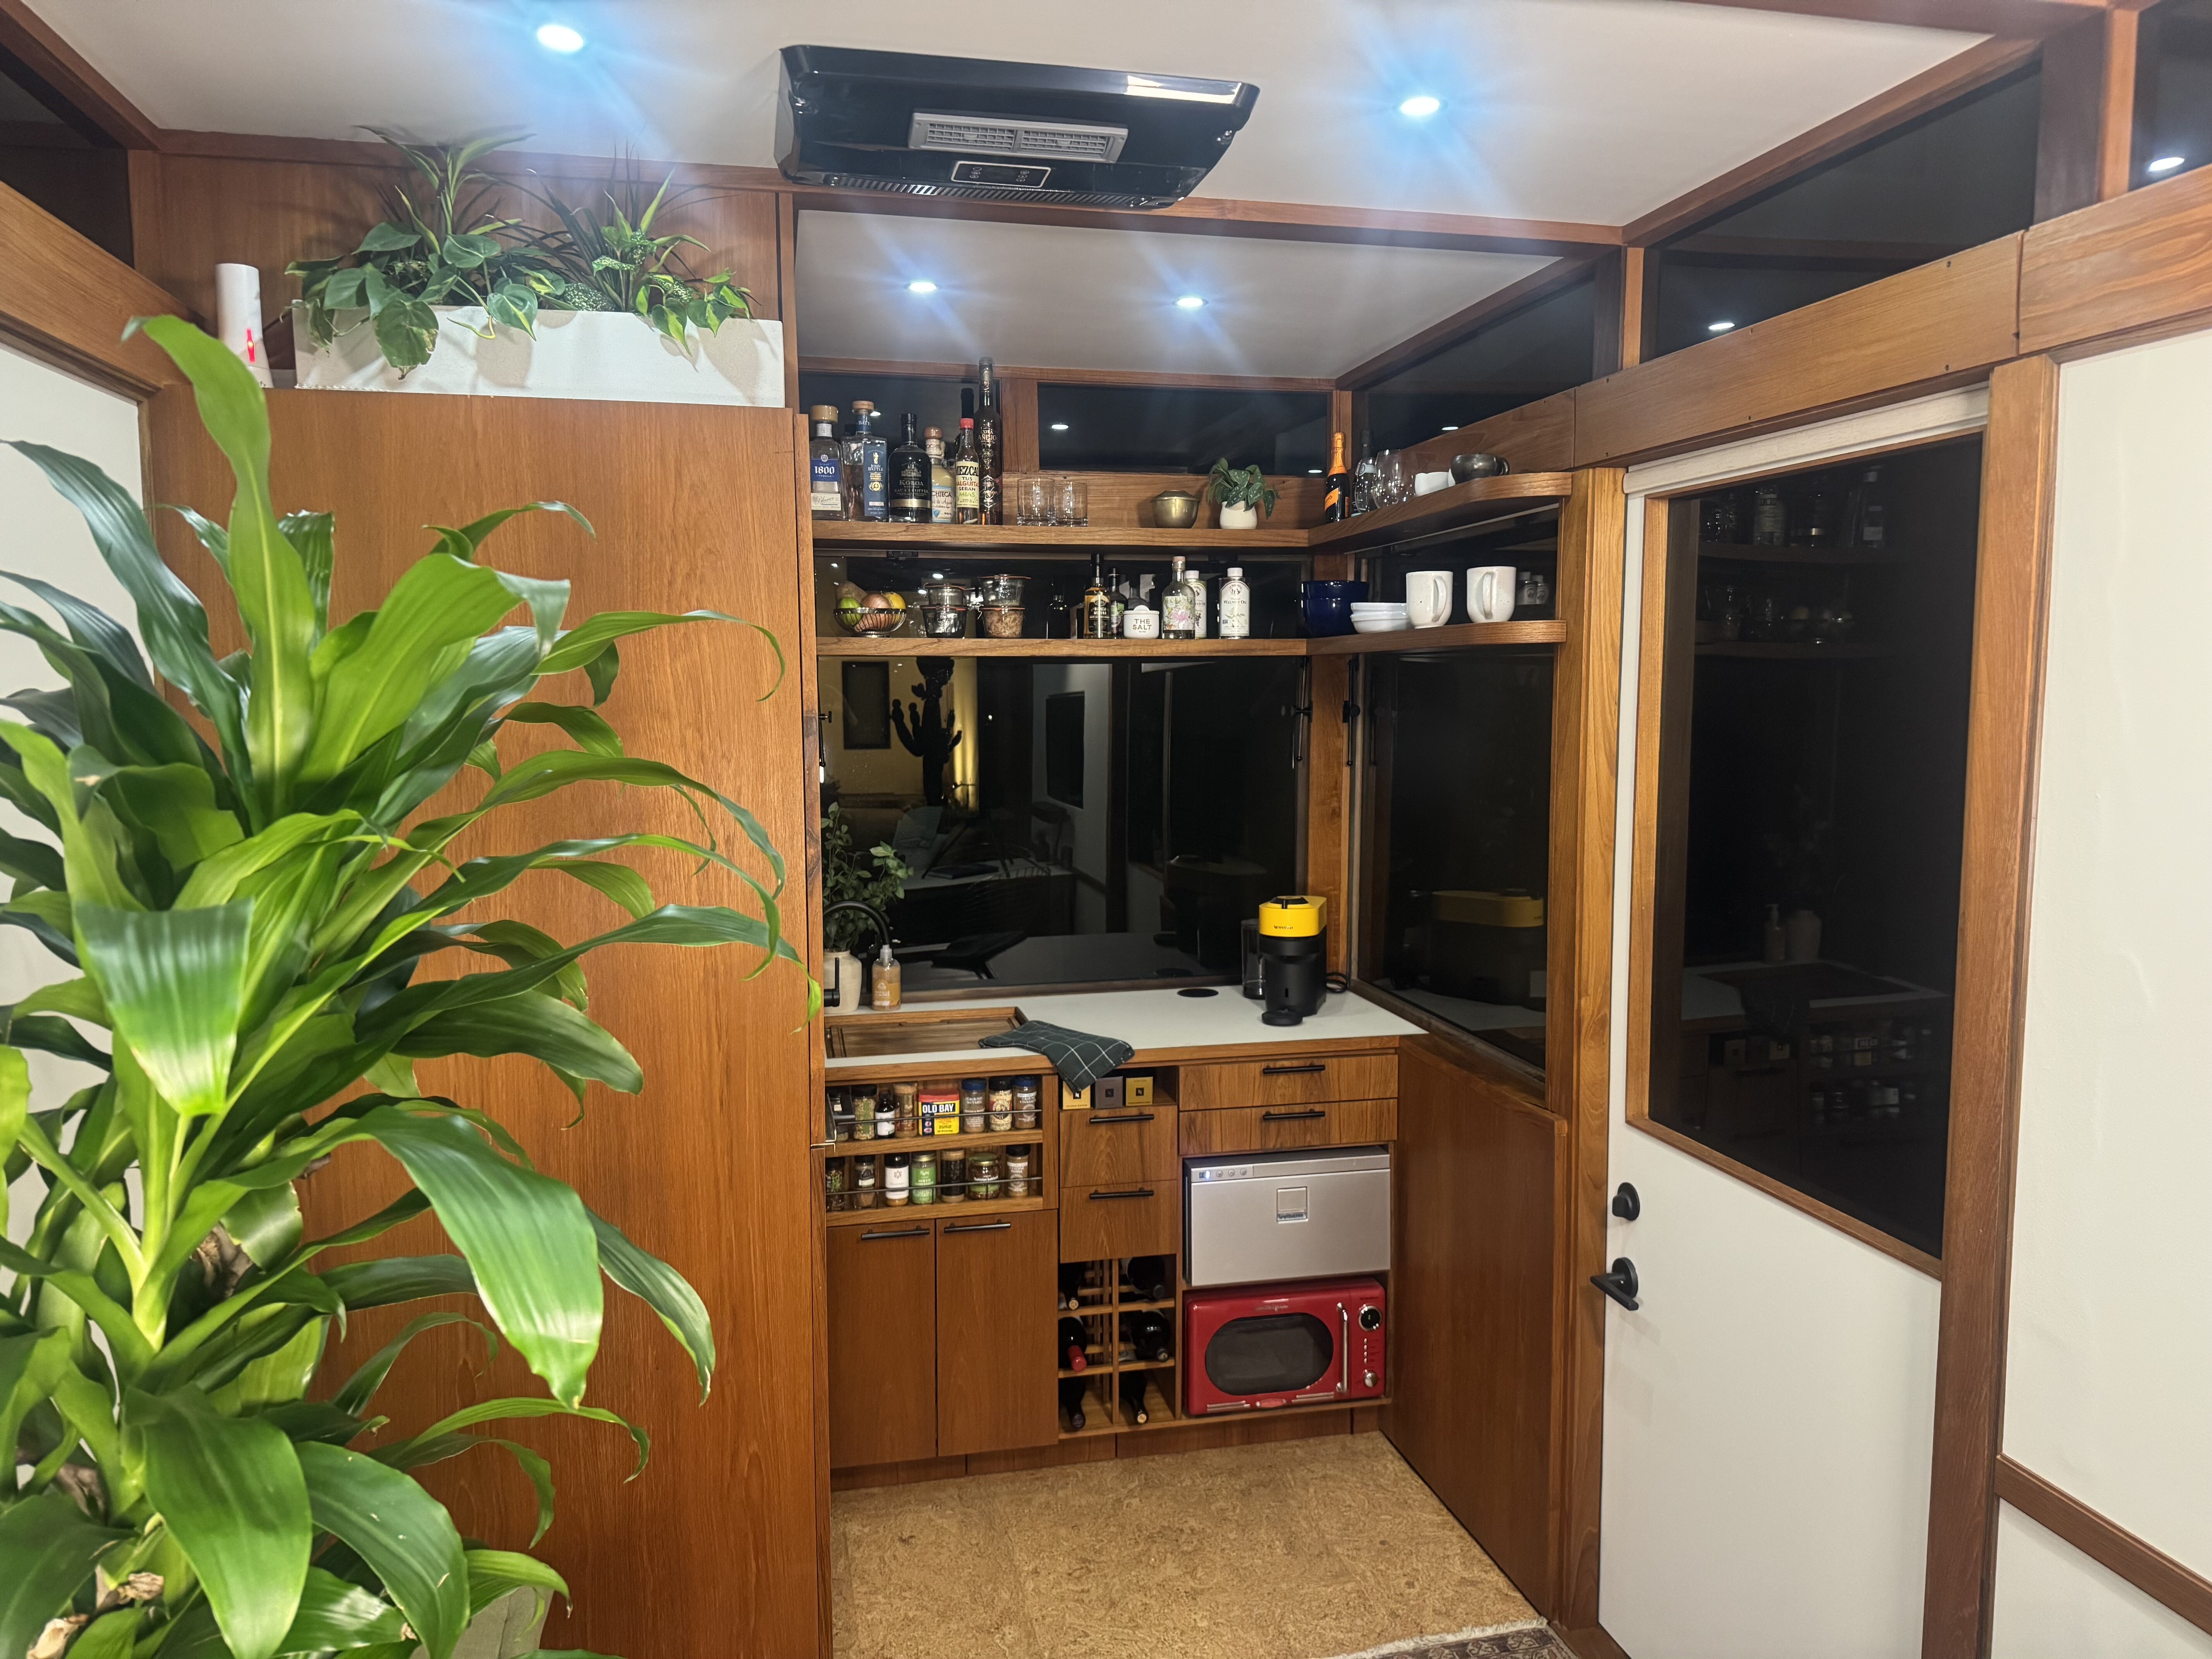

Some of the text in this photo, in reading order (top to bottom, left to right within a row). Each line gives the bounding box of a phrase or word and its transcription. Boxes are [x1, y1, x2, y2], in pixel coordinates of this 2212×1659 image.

[814, 466, 835, 474] 1800
[922, 1103, 953, 1113] OLD BAY
